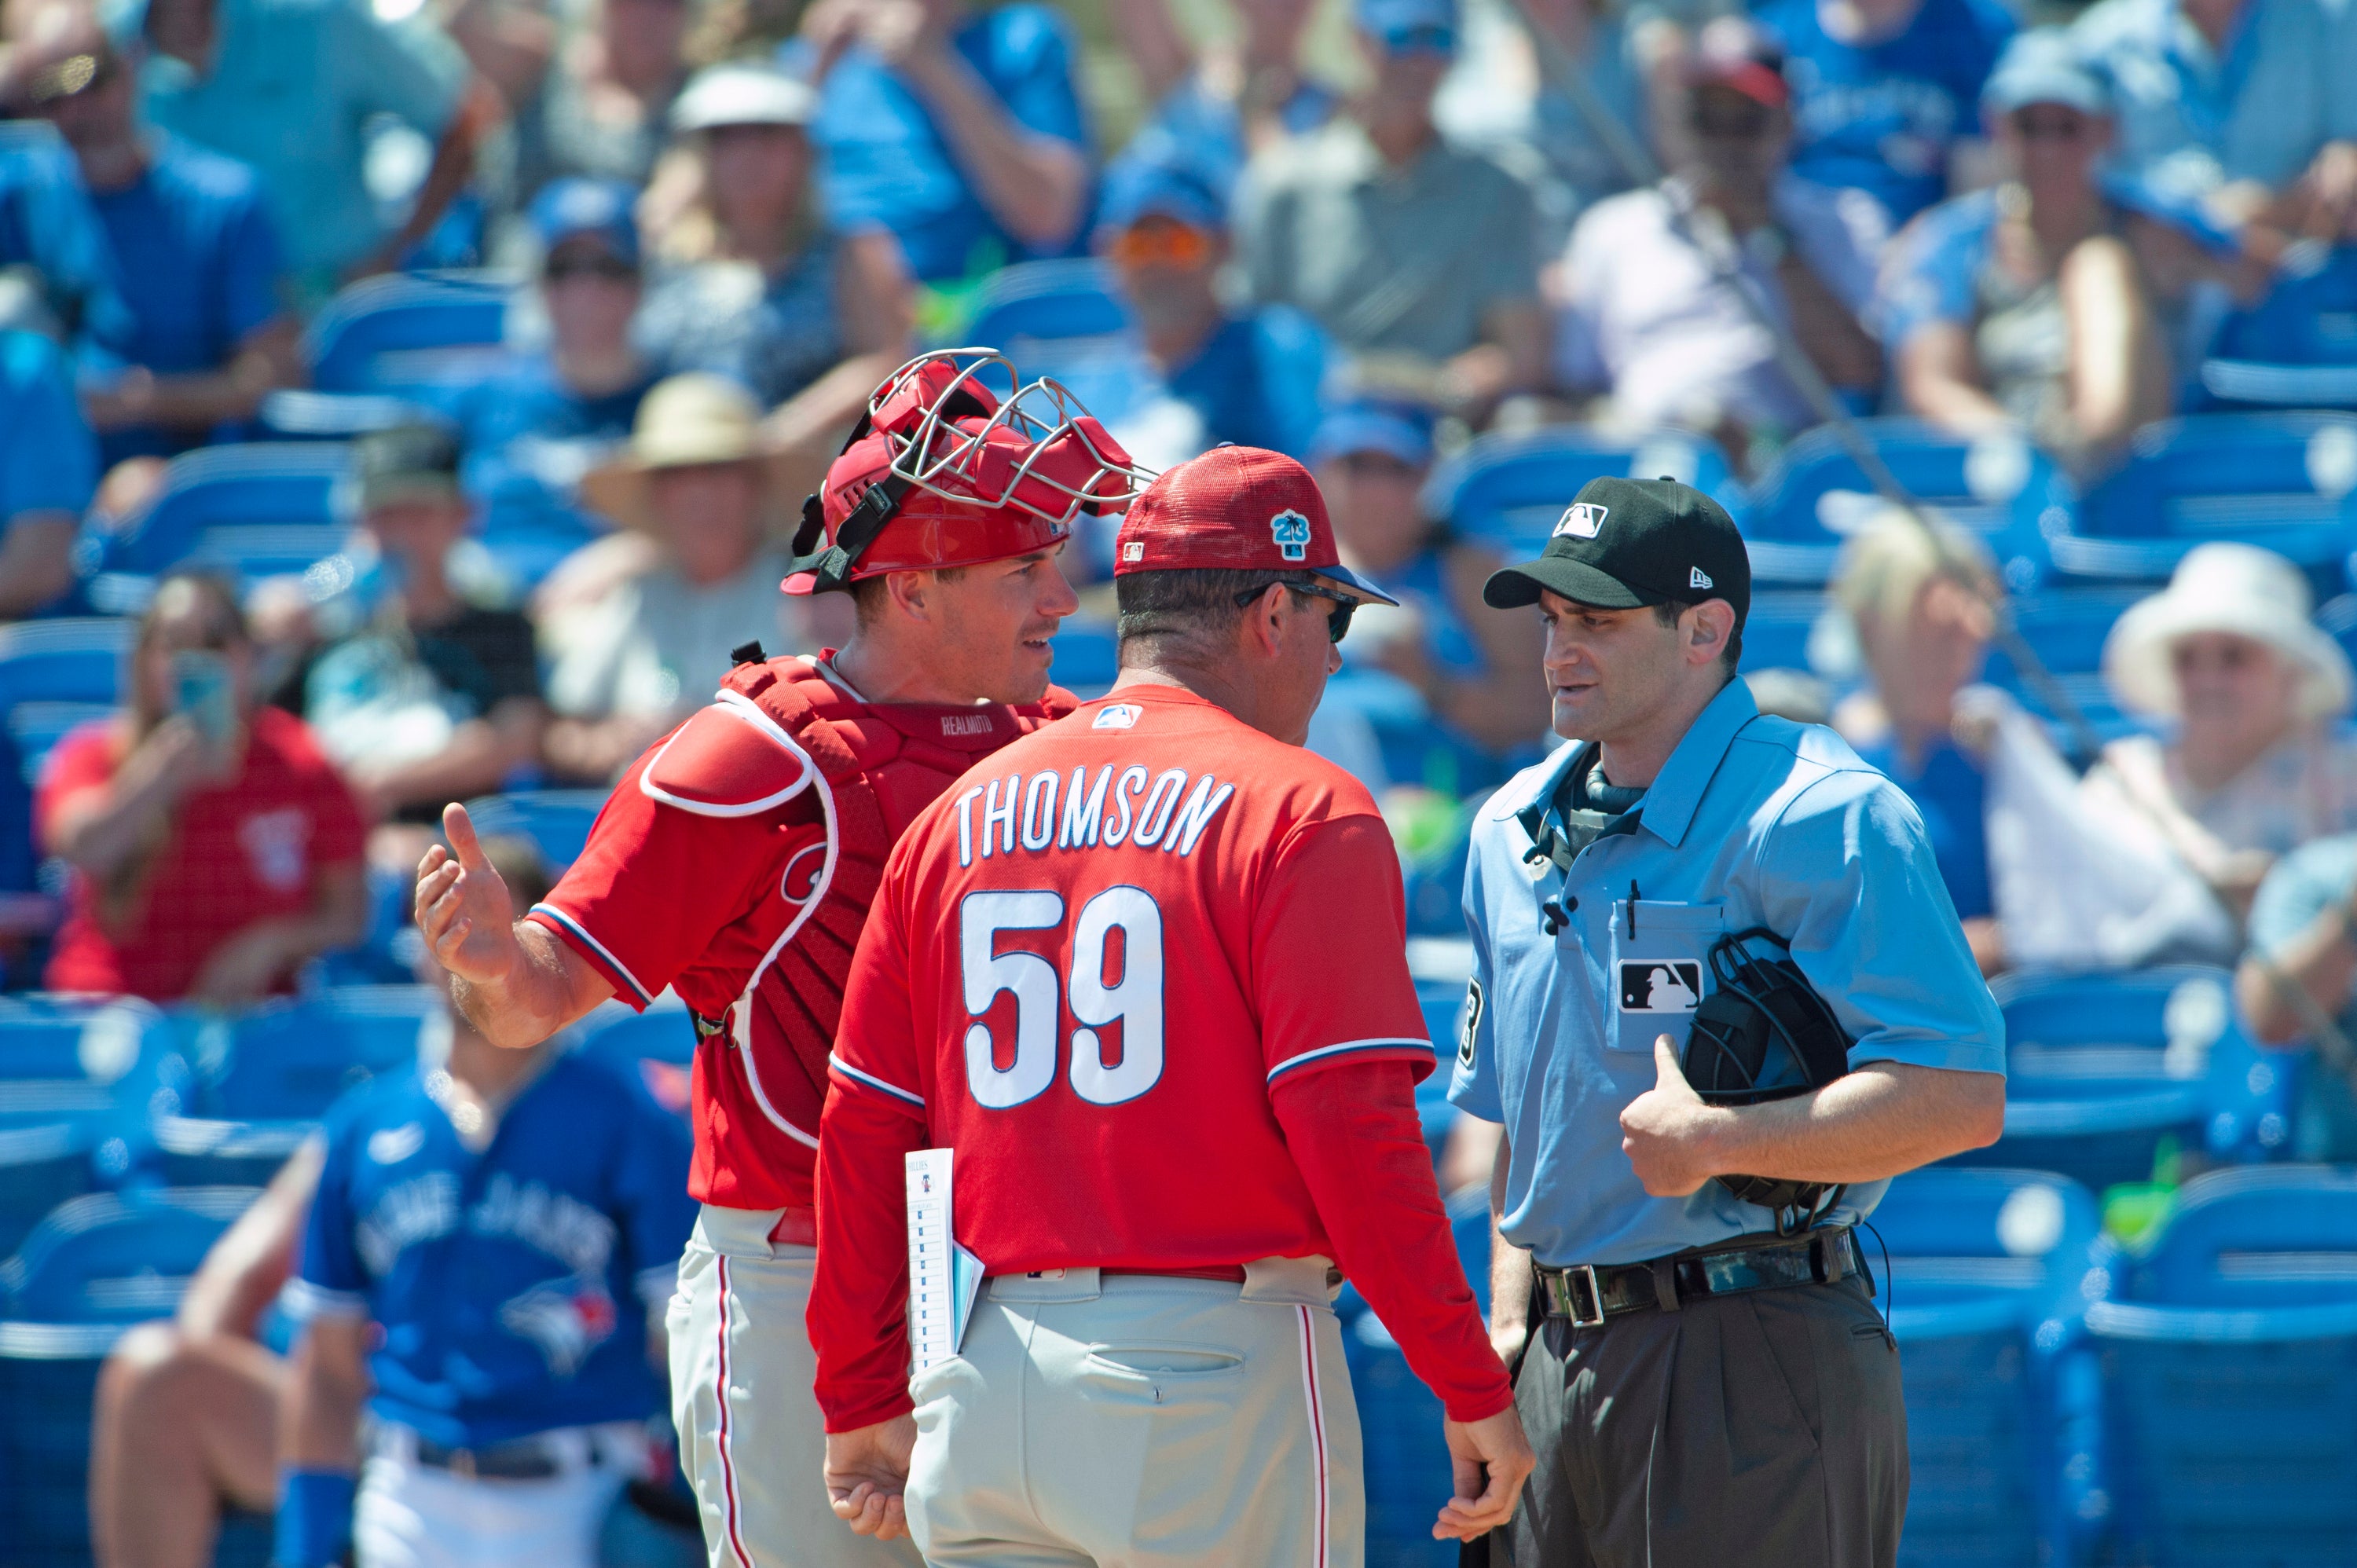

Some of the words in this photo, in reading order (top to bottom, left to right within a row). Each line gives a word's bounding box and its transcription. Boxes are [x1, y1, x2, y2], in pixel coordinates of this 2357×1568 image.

[1274, 517, 1309, 542] 23
[954, 764, 1235, 868] THOMSON
[960, 885, 1165, 1109] 59
